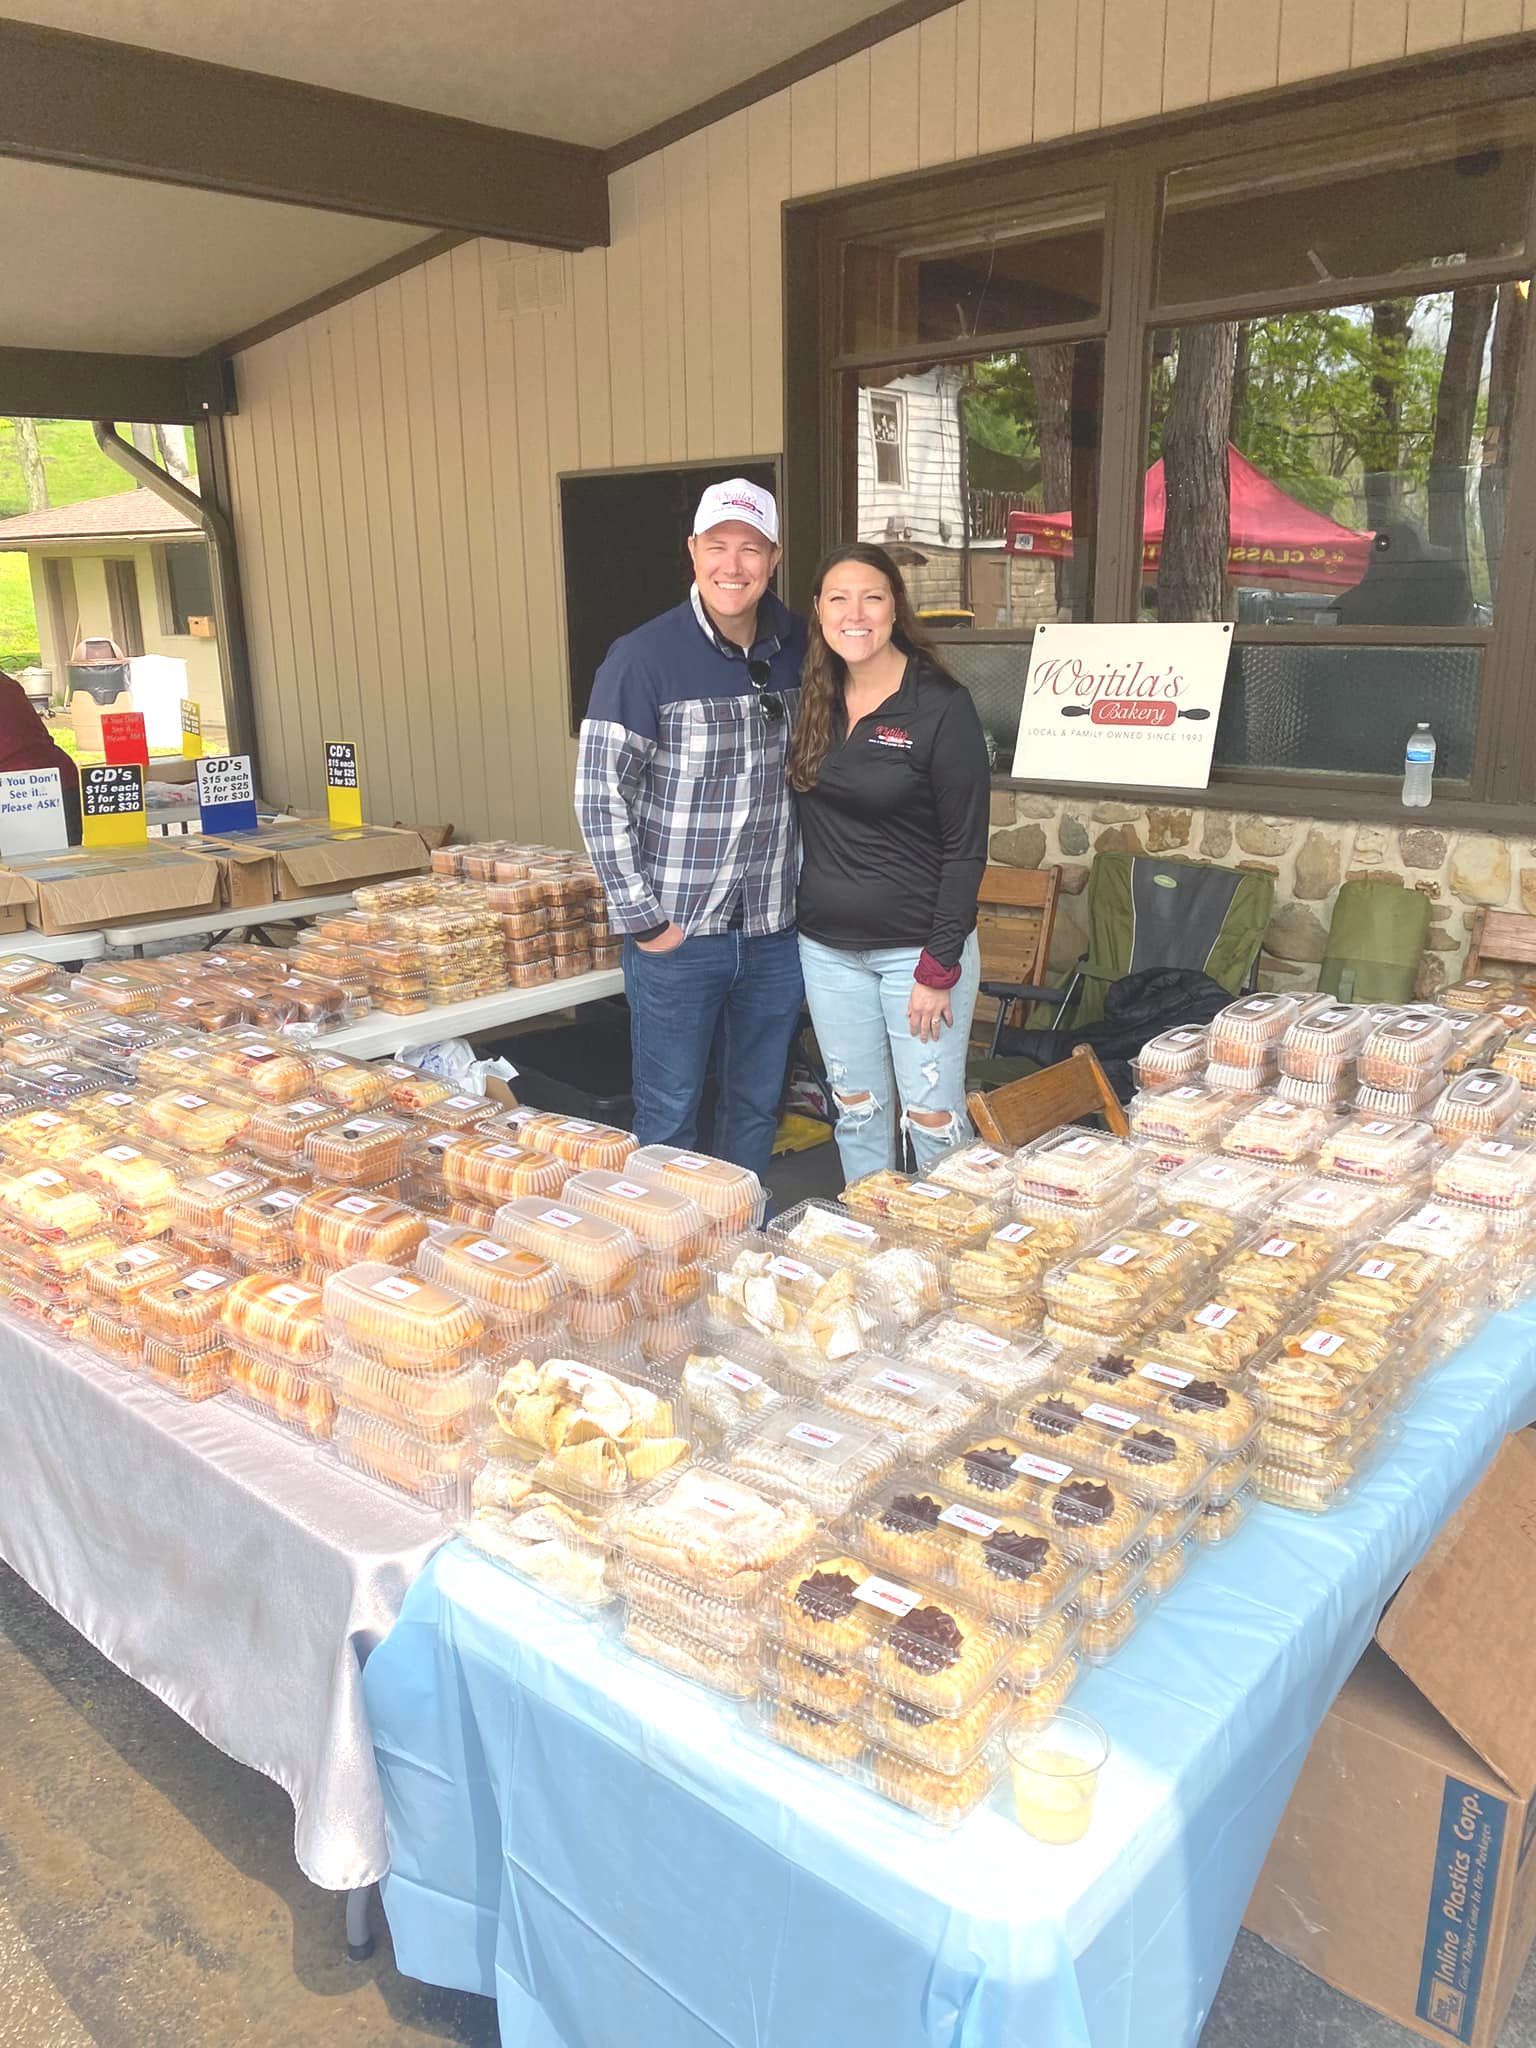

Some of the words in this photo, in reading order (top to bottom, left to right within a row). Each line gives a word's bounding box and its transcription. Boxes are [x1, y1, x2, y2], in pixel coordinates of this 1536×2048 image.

[1033, 658, 1188, 707] Wojtila's
[1098, 701, 1168, 725] Bakery
[1027, 727, 1057, 737] LOCAL
[1061, 729, 1067, 737] &
[1070, 729, 1102, 739] FAMILY
[1106, 731, 1143, 740] OWNED
[1147, 732, 1177, 741] SINCE
[1181, 733, 1203, 743] 1993
[329, 745, 351, 758] CD's
[205, 759, 242, 773] CD's
[7, 776, 26, 786] You
[30, 773, 58, 784] Don't
[90, 768, 132, 782] CD's
[202, 775, 221, 785] $15
[224, 773, 248, 782] each
[10, 789, 28, 799] See
[32, 787, 48, 796] it...
[85, 785, 108, 795] $15
[110, 782, 139, 793] each
[203, 786, 210, 794] 2
[213, 785, 227, 793] for
[230, 781, 249, 791] $25
[87, 795, 95, 804] 2
[98, 794, 115, 803] for
[117, 791, 139, 802] $25
[204, 795, 211, 803] 3
[214, 794, 228, 802] for
[231, 791, 250, 800] $30
[1, 802, 33, 813] Please
[36, 799, 59, 809] ASK!
[88, 805, 95, 814] 3
[98, 804, 115, 813] for
[118, 801, 140, 812] $30
[1453, 1793, 1483, 1841] Corp.
[1442, 1849, 1470, 1923] Plastics
[1434, 1930, 1459, 1984] Inline
